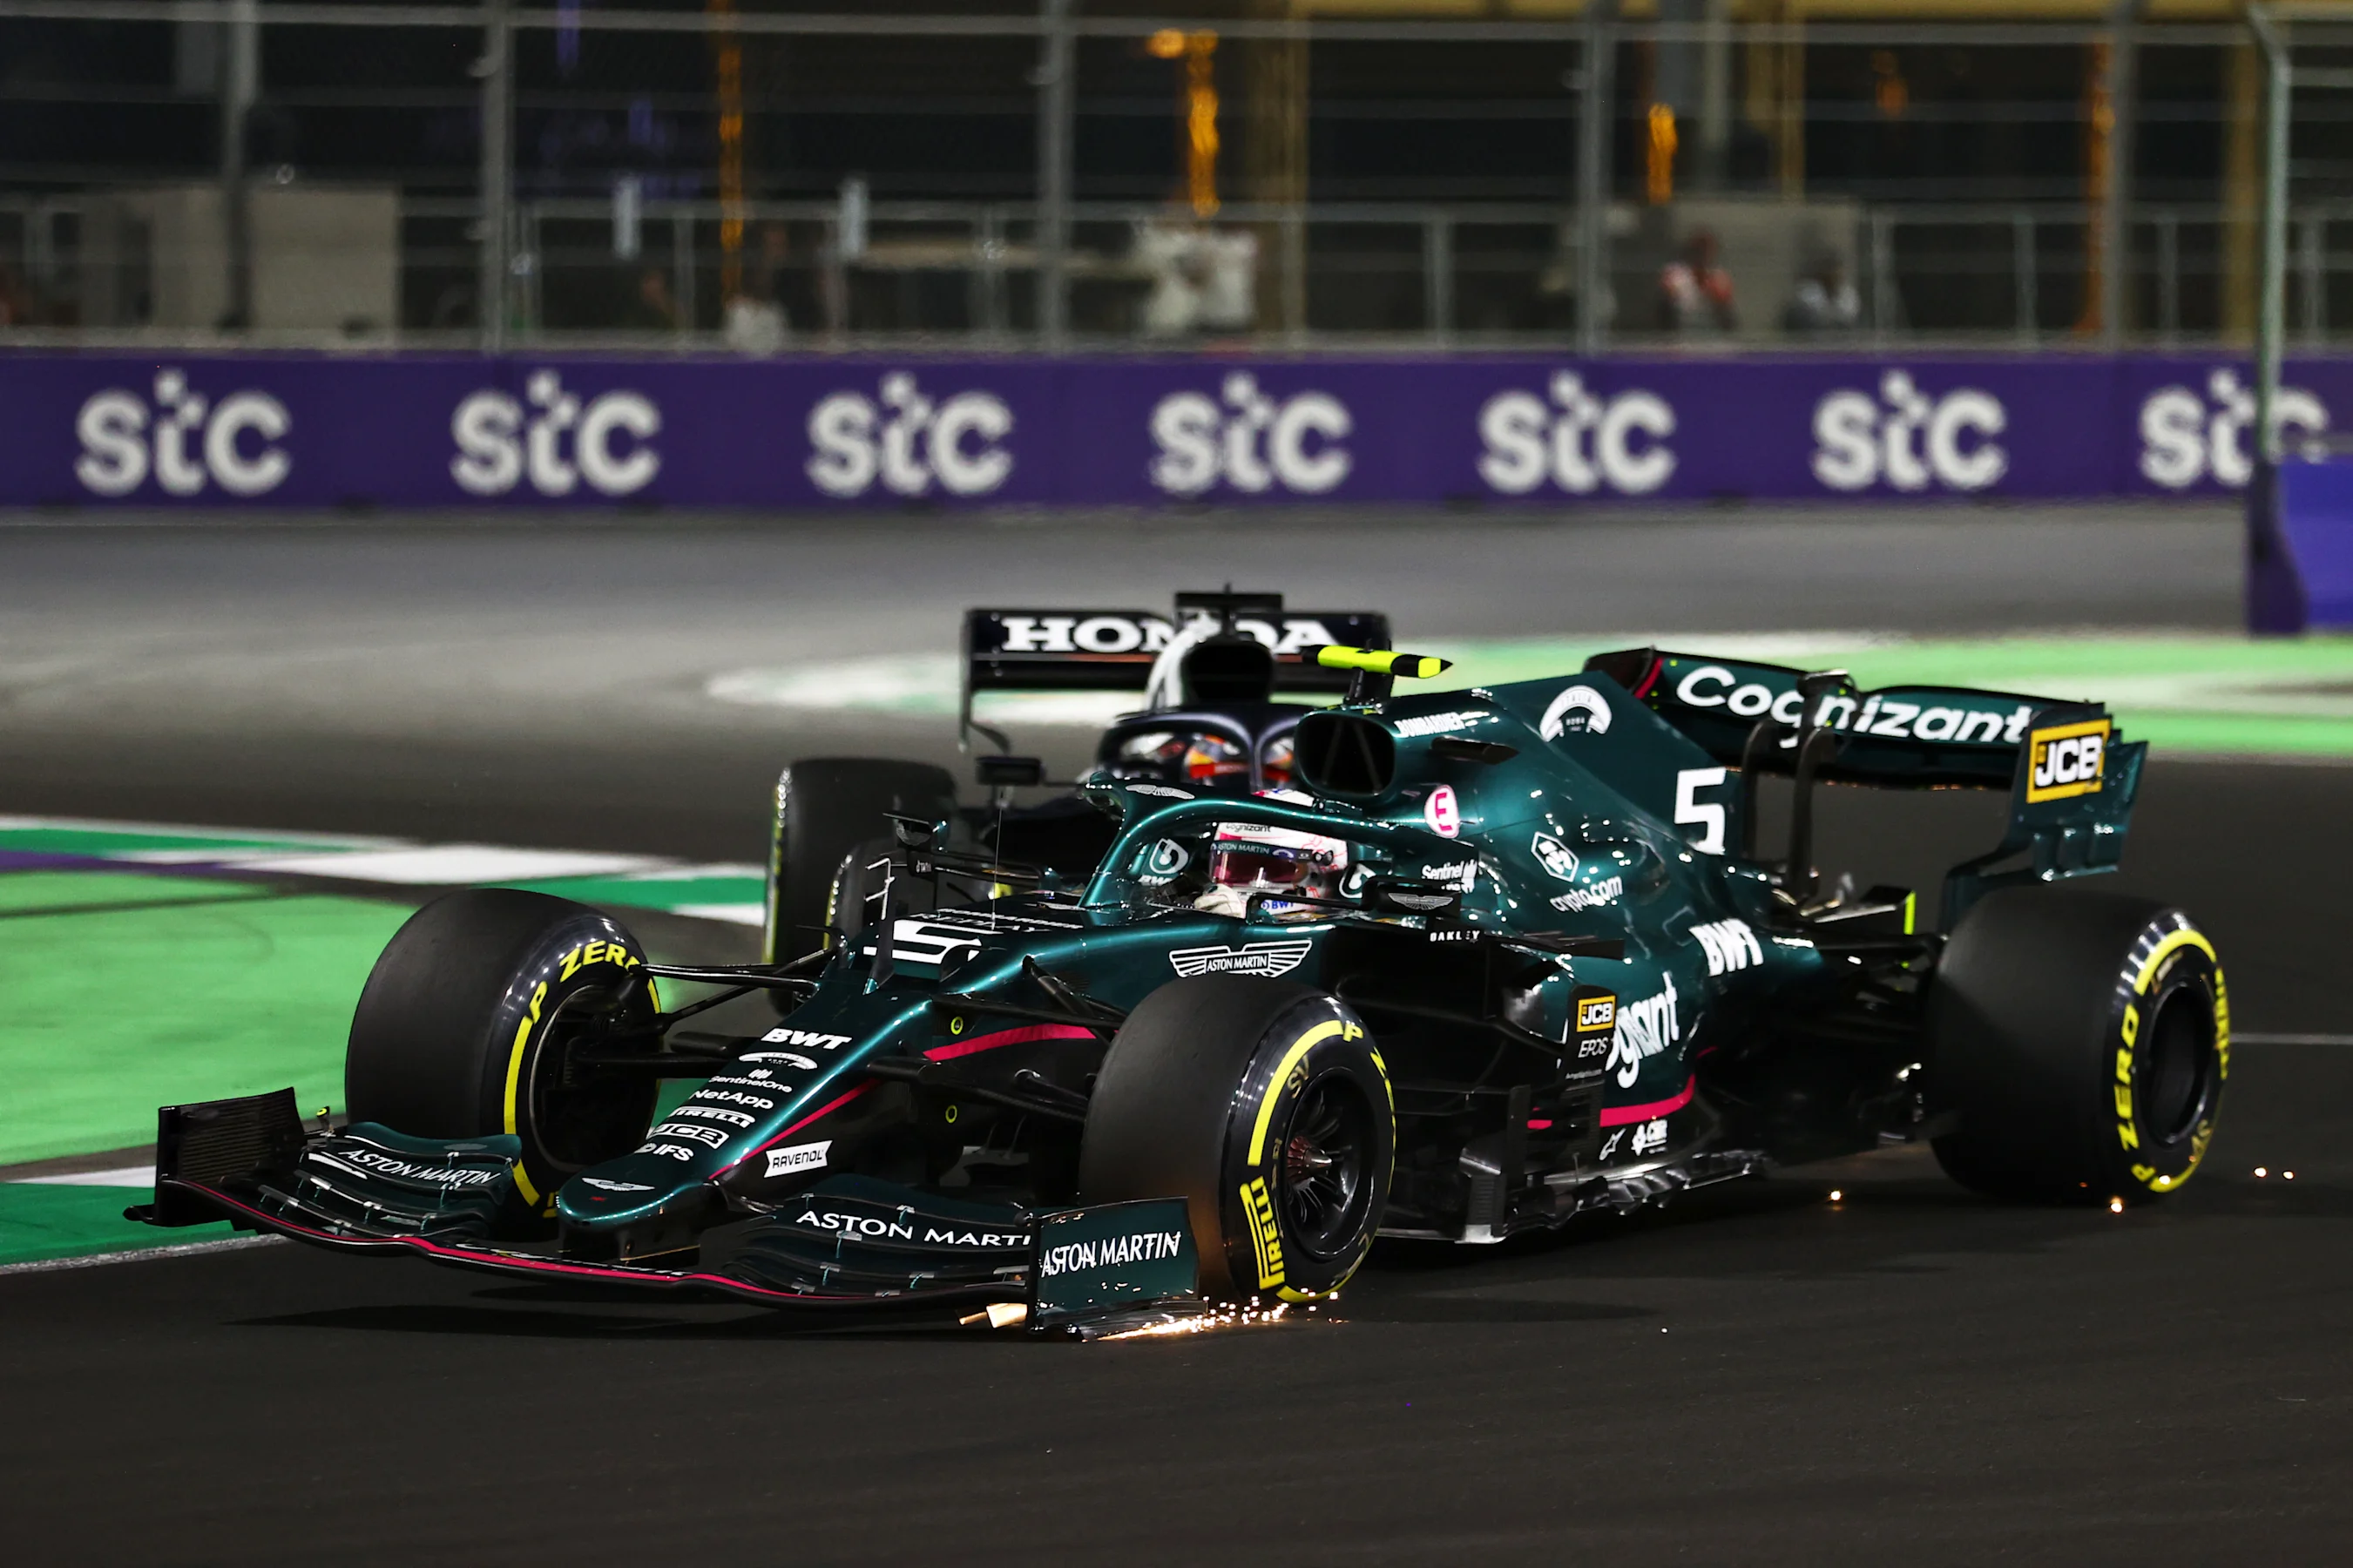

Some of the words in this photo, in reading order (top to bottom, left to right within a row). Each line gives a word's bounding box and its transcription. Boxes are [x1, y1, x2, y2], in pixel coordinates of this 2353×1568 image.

[77, 372, 288, 492] stc
[451, 371, 659, 492] stc
[808, 373, 1011, 492] stc
[1150, 373, 1350, 492] stc
[1479, 372, 1675, 492] stc
[1813, 371, 2005, 490] stc
[1676, 666, 2032, 749] Cognizant
[2034, 734, 2103, 787] JCB
[1674, 766, 1726, 855] 5
[1238, 843, 1270, 855] MARTIN
[1137, 874, 1173, 886] BW
[1430, 929, 1481, 942] OAKLEY
[1688, 918, 1764, 977] BWT
[1207, 957, 1234, 972] ASTON
[1234, 955, 1268, 970] MARTIN
[1580, 1003, 1613, 1025] JCB
[761, 1028, 853, 1050] BWT
[1578, 1037, 1609, 1058] EPOS
[688, 1088, 774, 1110] NetApp
[708, 1075, 793, 1093] SentinelOne
[667, 1105, 757, 1129] PIRELLI
[337, 1148, 423, 1177] ASTON
[410, 1166, 502, 1185] MARTIN
[652, 1144, 695, 1162] IFS
[772, 1150, 824, 1169] RAVENOL
[796, 1210, 914, 1240] ASTON
[923, 1228, 1031, 1247] MARTI
[1239, 1175, 1286, 1291] PIRELLI
[1041, 1240, 1097, 1278] ASTON
[1099, 1231, 1181, 1267] MARTIN
